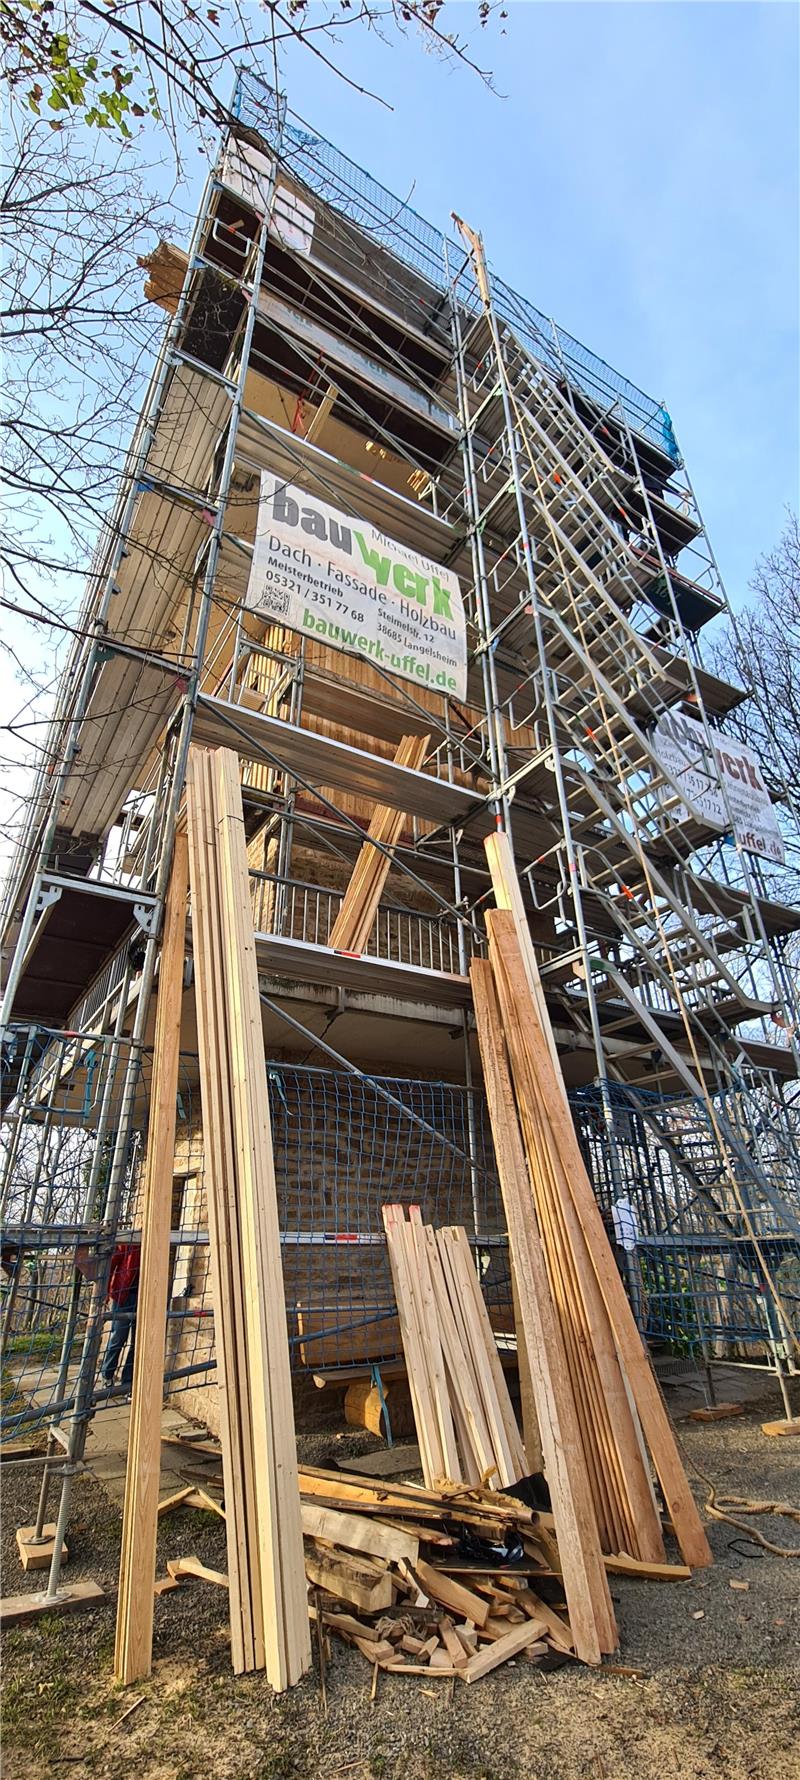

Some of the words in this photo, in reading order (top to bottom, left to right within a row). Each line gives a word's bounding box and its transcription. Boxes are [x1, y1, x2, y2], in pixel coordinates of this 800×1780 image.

[267, 556, 344, 598] Meisterbetrieb
[268, 535, 312, 567] Dach
[327, 561, 388, 605] Fassade
[400, 601, 457, 640] Holzbau
[421, 559, 450, 582] Uffel
[265, 570, 302, 594] 05321
[311, 591, 332, 607] 351
[335, 600, 349, 616] 77
[350, 609, 365, 623] 68
[376, 623, 402, 643] 38685
[403, 637, 458, 666] Langelsheim
[377, 607, 422, 640] Steimelstr.
[423, 633, 435, 643] 12
[302, 608, 457, 691] bauwerk-uffel.de
